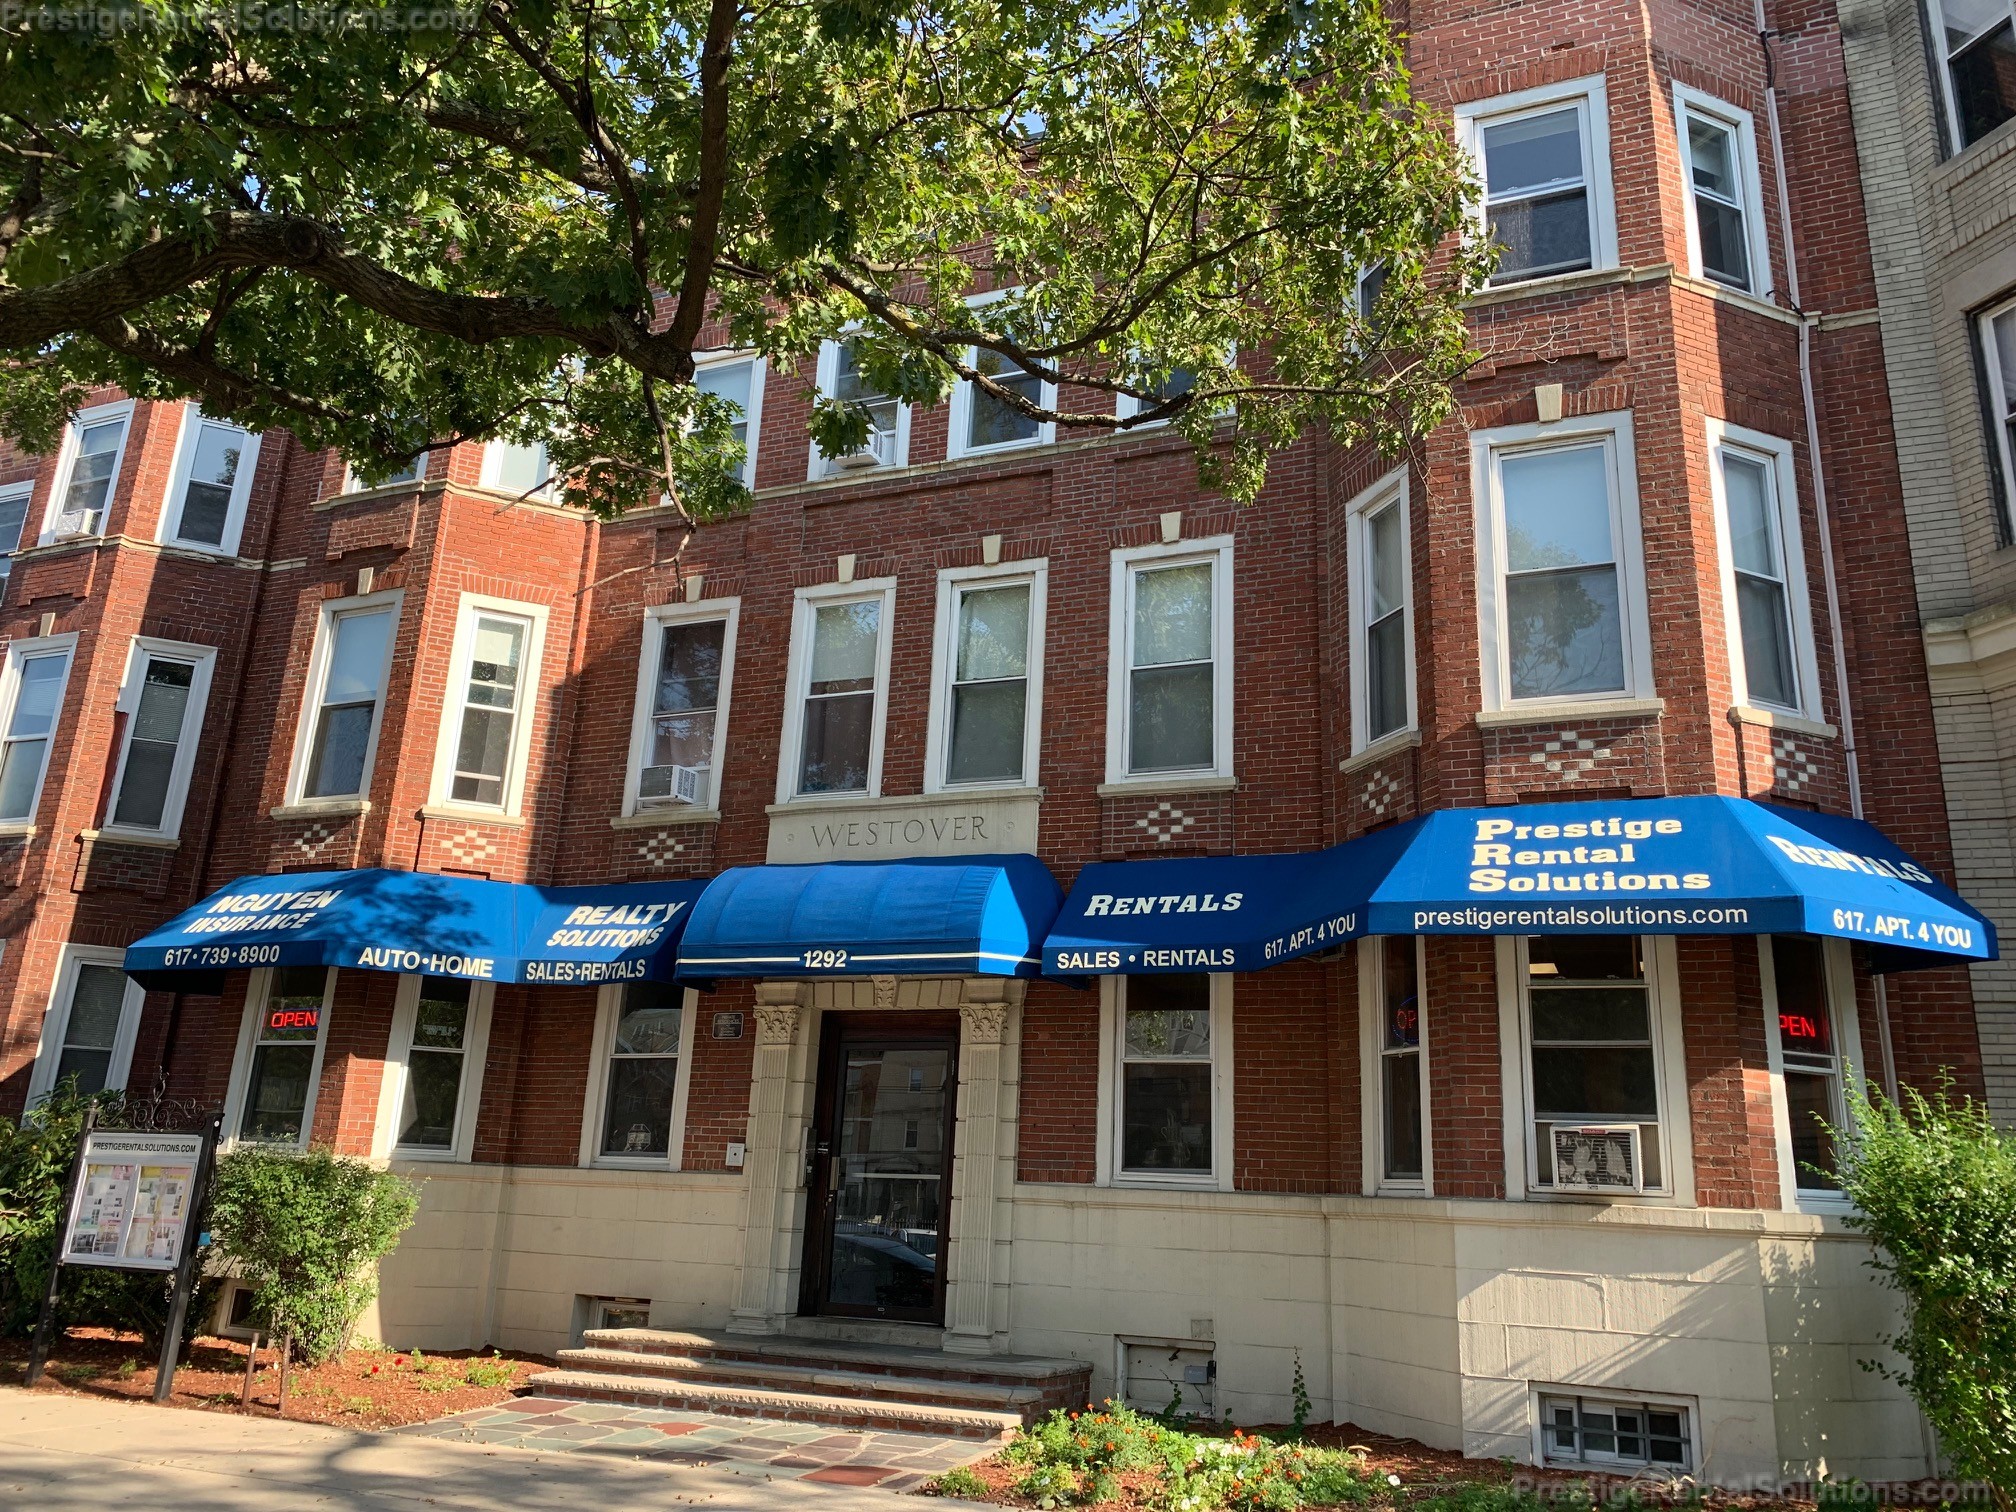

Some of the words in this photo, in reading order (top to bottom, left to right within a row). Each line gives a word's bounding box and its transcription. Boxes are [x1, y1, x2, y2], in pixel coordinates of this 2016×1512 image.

[811, 816, 988, 848] WESTOVER
[1475, 817, 1683, 841] Prestige
[1471, 844, 1636, 866] Rental
[1765, 834, 1933, 884] RENTALS
[1469, 868, 1711, 892] Solutions
[206, 890, 343, 914] NGUYEN
[563, 901, 687, 926] REALTY
[1084, 893, 1243, 917] RENTALS
[182, 912, 317, 934] INSURANCE
[1414, 906, 1748, 929] prestigerentalsolutions.com
[1833, 908, 1870, 933] 617.
[1874, 915, 1914, 939] APT.
[1917, 922, 1929, 942] 4
[1931, 923, 1972, 949] YOU
[547, 926, 664, 948] SOLUTIONS
[1264, 938, 1287, 960] 617.
[1289, 927, 1315, 952] APT.
[1317, 923, 1325, 941] 4
[1328, 913, 1355, 937] YOU
[803, 950, 847, 968] 1292
[1057, 951, 1120, 969] SALES
[1143, 948, 1235, 967] RENTALS
[271, 1010, 318, 1028] OPEN
[93, 1142, 196, 1153] PRESTIGERENTALSOLUTIONS.COM
